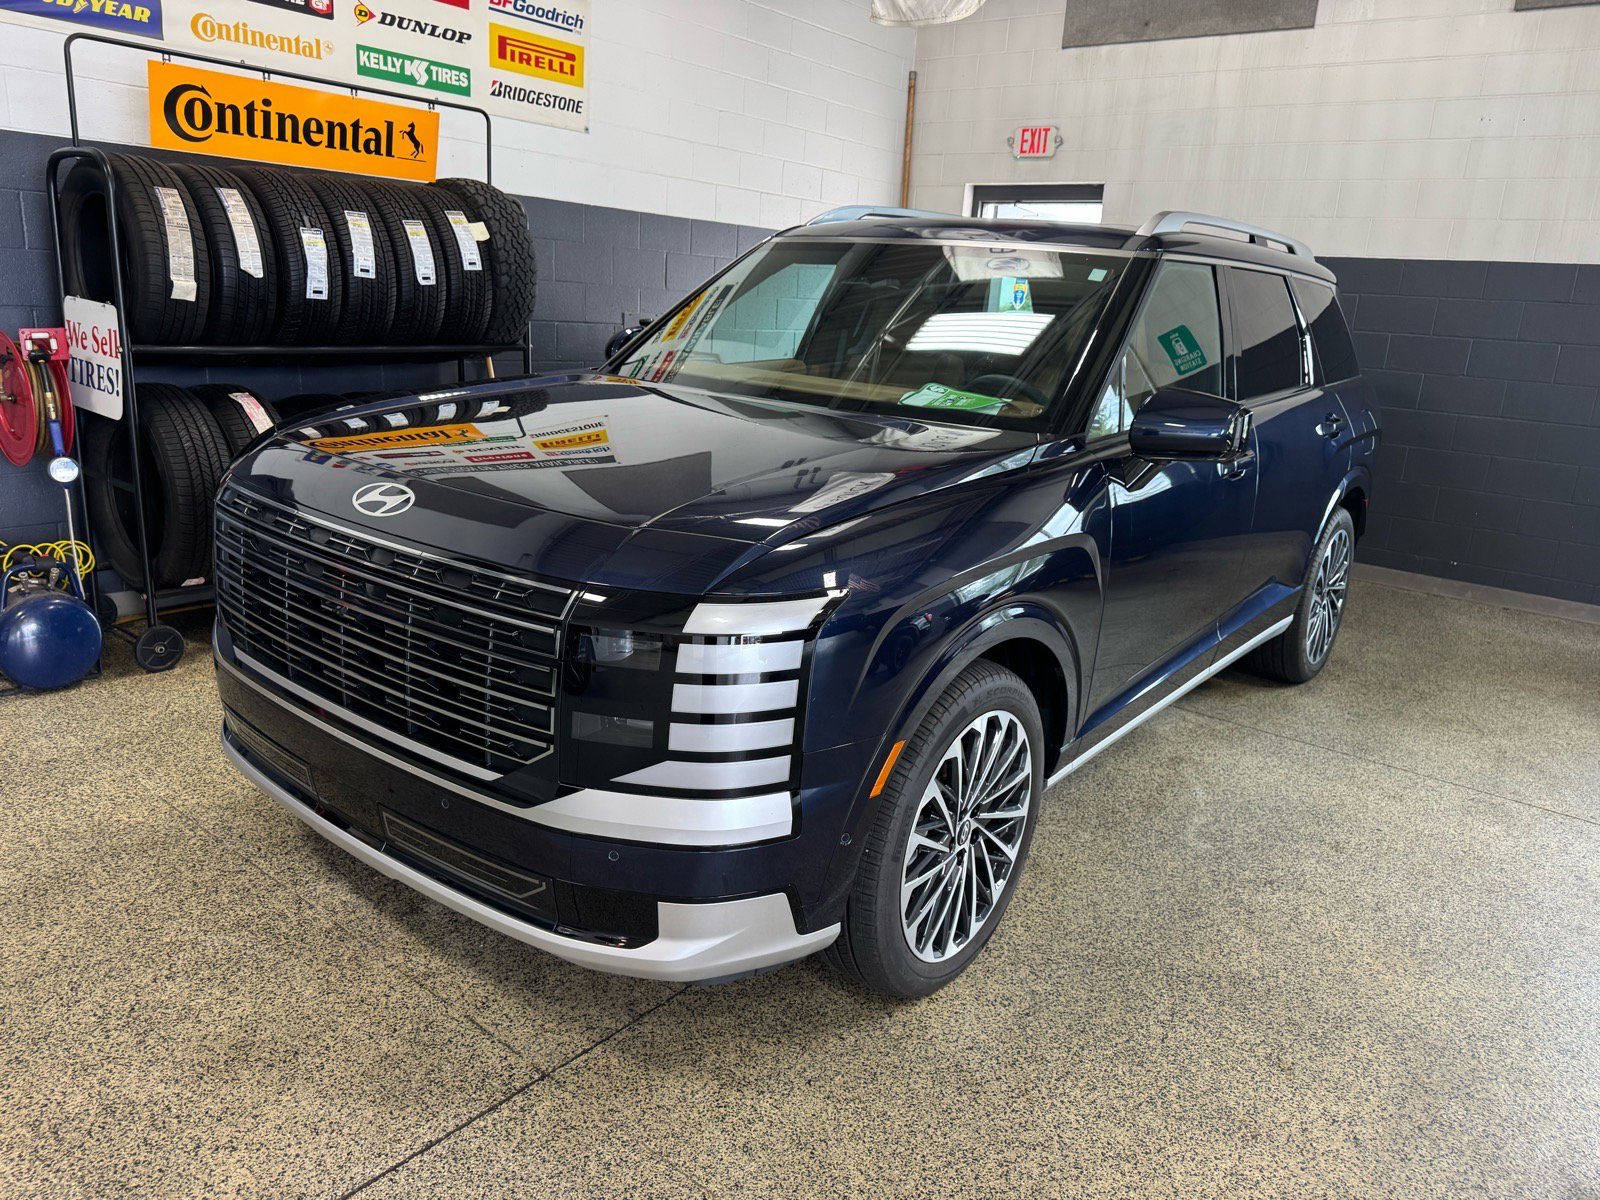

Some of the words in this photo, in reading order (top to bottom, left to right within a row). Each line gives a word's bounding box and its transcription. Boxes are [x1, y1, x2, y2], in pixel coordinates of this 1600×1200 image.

[191, 12, 323, 60] Continental
[378, 12, 472, 44] DUNLOP
[359, 50, 403, 74] KELLY
[430, 65, 469, 88] TIRES
[498, 35, 577, 76] PIRELLI
[490, 80, 584, 114] BRIDGESTONE
[164, 84, 395, 158] Continental
[1020, 128, 1051, 154] EXIT
[66, 319, 88, 350] We
[91, 325, 120, 359] Sell
[70, 355, 120, 397] TIRES!
